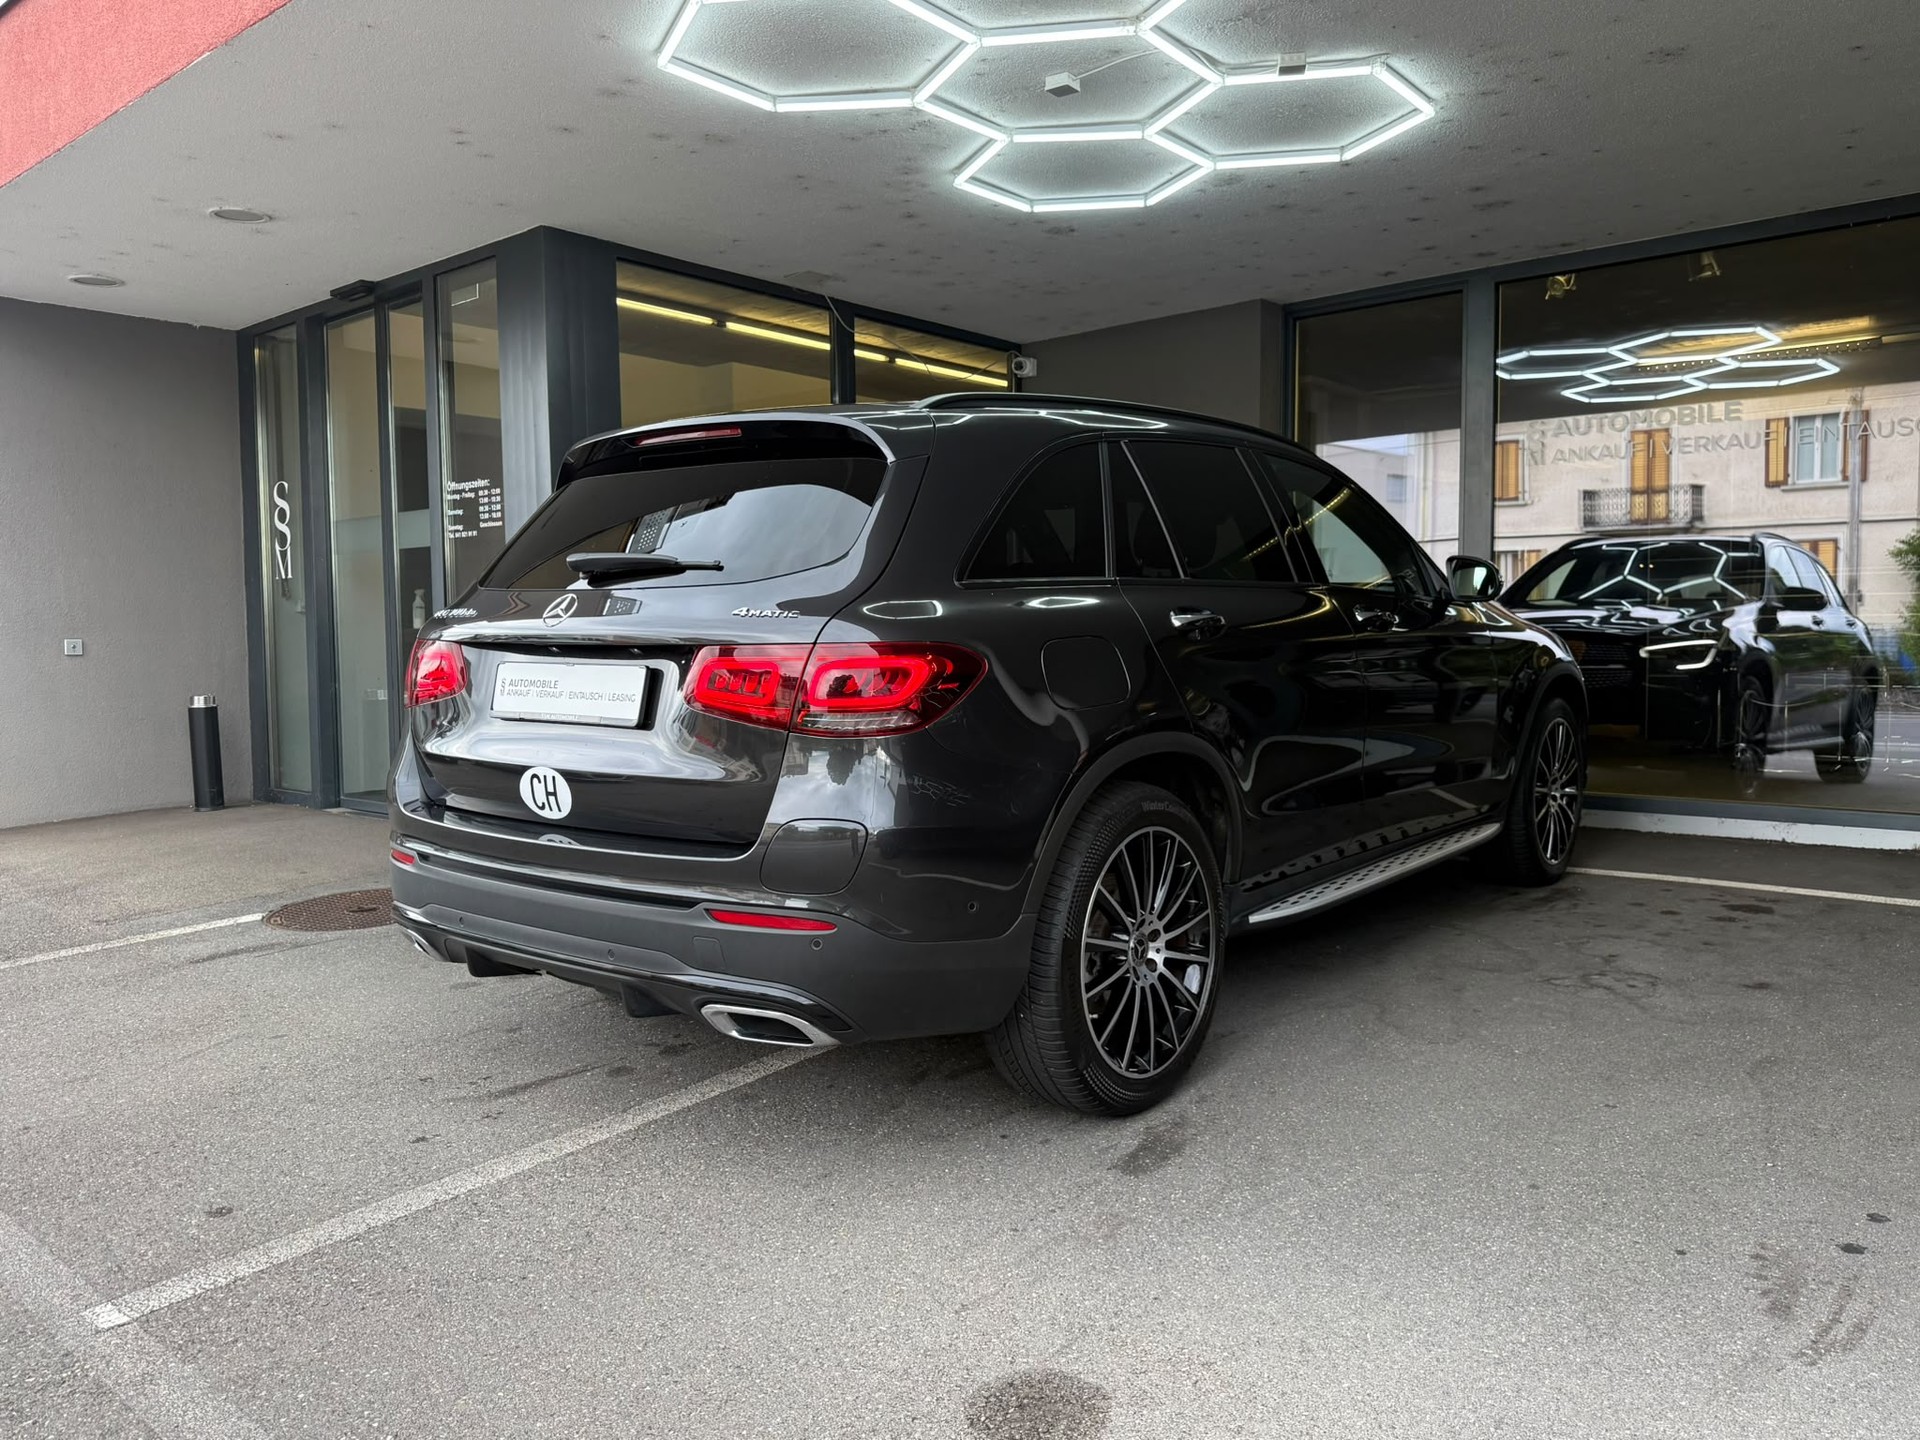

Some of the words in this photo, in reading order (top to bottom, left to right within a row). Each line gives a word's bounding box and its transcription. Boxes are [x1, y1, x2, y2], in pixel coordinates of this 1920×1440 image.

[1552, 401, 1743, 438] AUTOMOBILE
[1551, 439, 1646, 465] ANKAUF
[1662, 428, 1778, 456] VERKAUF
[1799, 416, 1920, 446] EINTAUS
[731, 606, 800, 618] 4MATIC
[507, 688, 531, 697] ANKAUF
[535, 689, 564, 699] VERKAUF
[568, 691, 603, 701] EINTAUSCH
[608, 692, 636, 702] LEASING
[508, 679, 559, 689] AUTOMOBILE
[530, 773, 562, 812] CH
